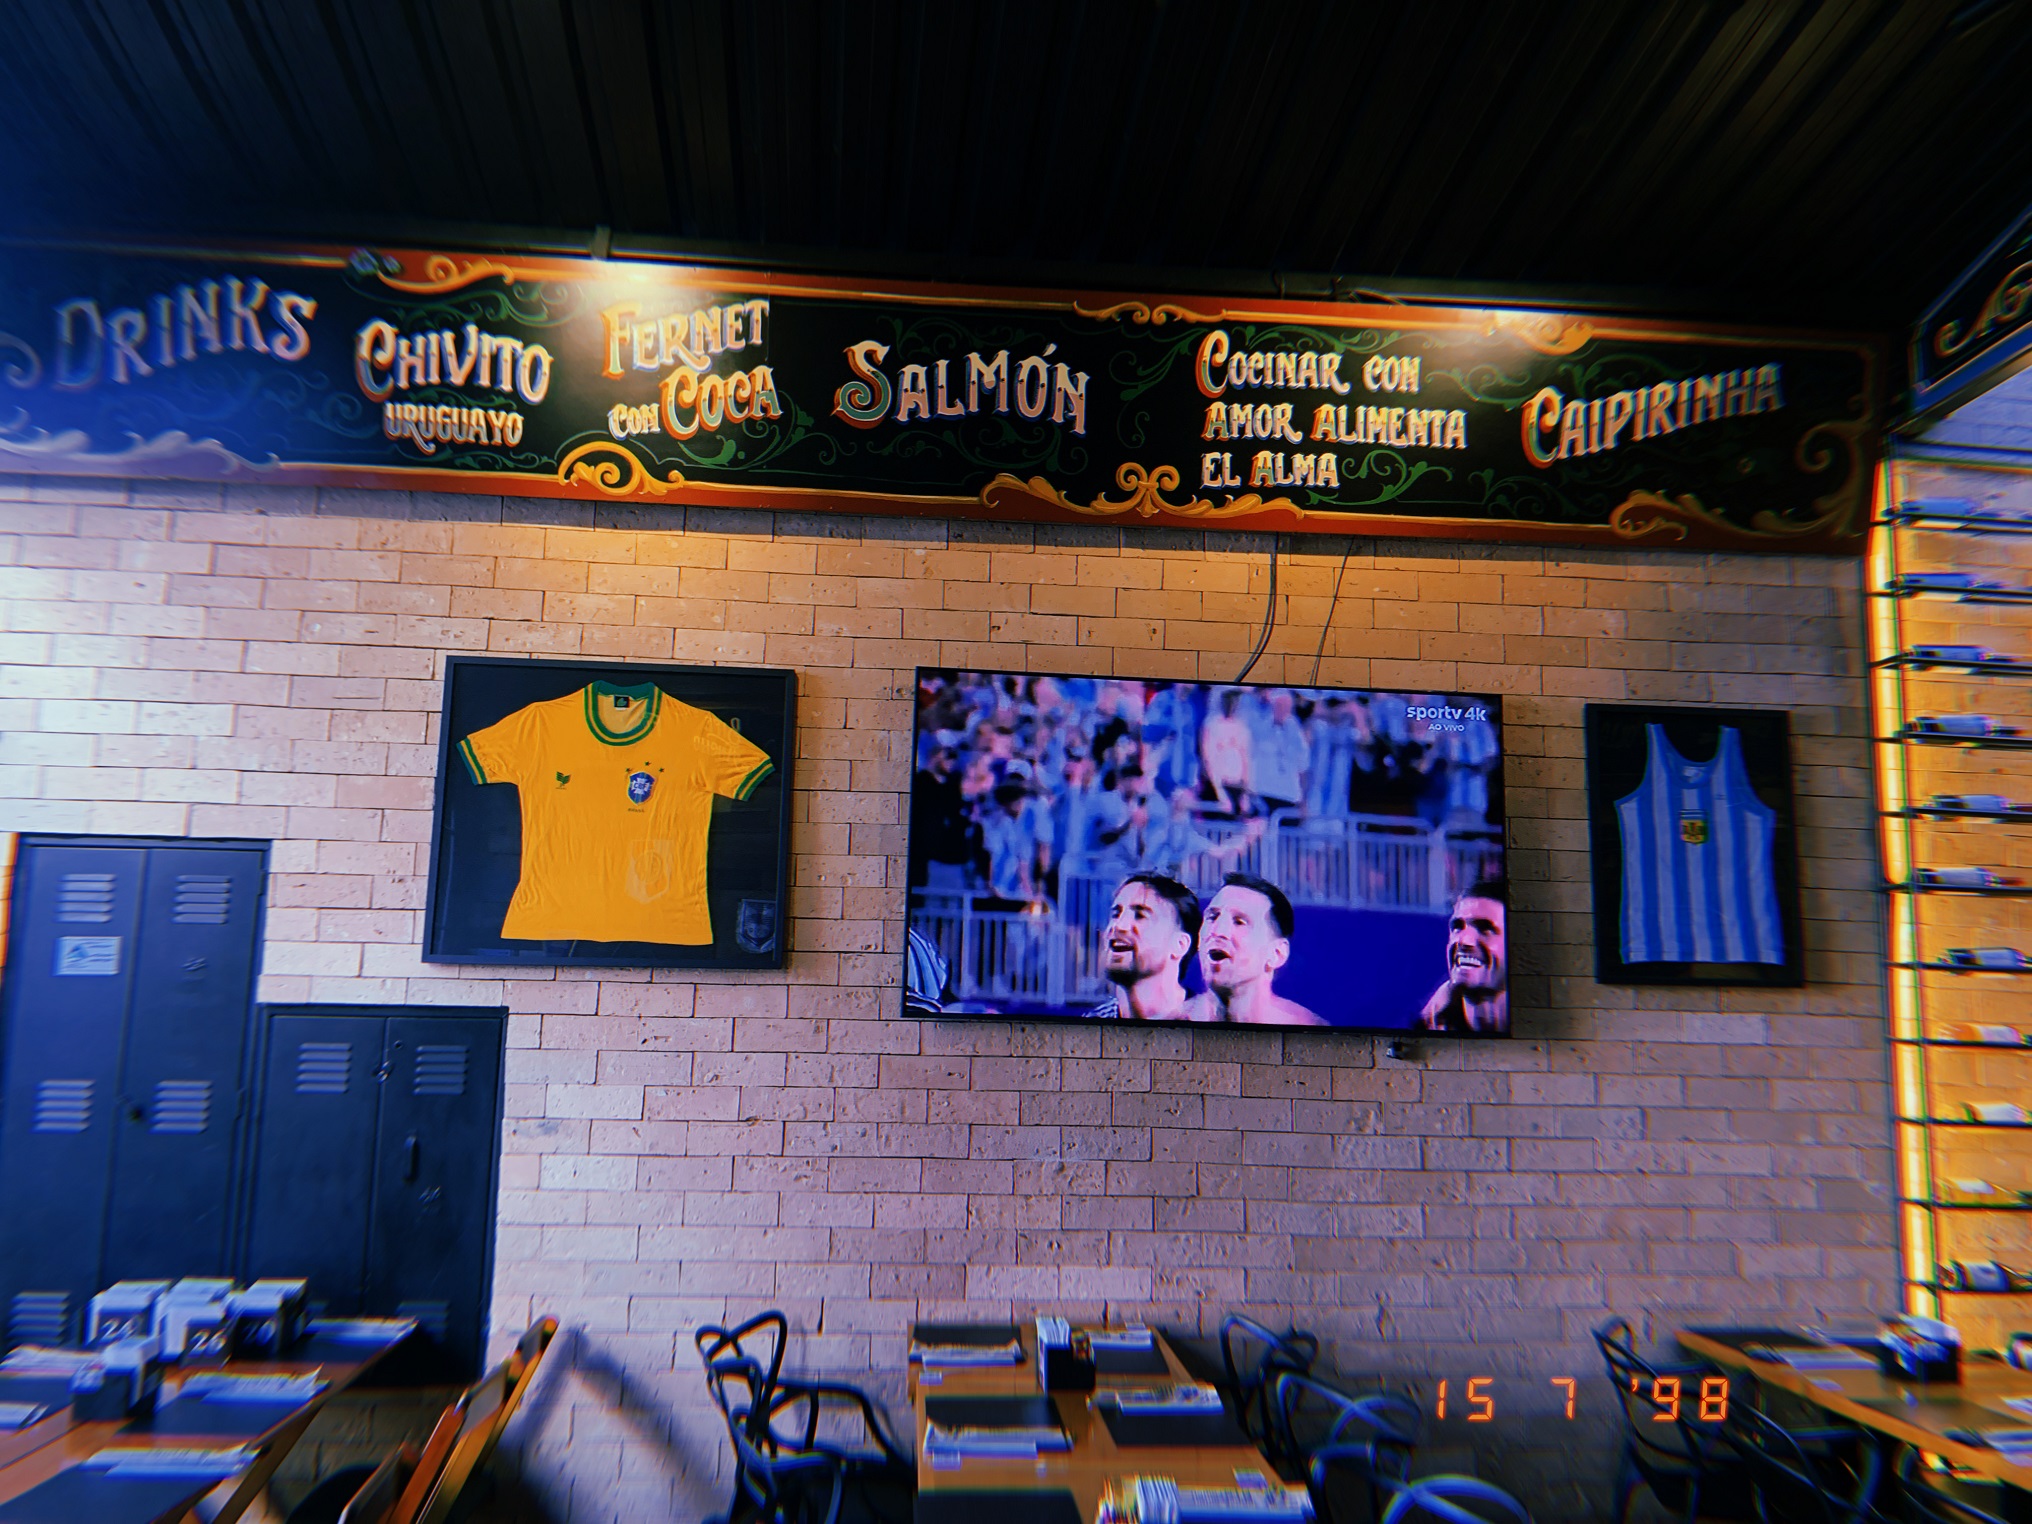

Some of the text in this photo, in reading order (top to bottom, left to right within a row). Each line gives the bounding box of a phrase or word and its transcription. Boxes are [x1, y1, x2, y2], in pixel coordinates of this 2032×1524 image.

[53, 274, 318, 391] DRINKS
[354, 318, 554, 405] CHIVITO
[602, 299, 769, 380] FERNET
[1195, 329, 1423, 398] COCINAR CON
[607, 365, 783, 441] CON COCA
[830, 340, 1091, 436] SALMÓN
[1520, 361, 1784, 468] CAIPIRINHA
[383, 401, 525, 454] URUGUAYO
[1200, 401, 1469, 449] AMOR ALIMENTA
[1199, 449, 1340, 490] EL ALMA
[1406, 705, 1487, 722] sportv 4k
[1428, 723, 1465, 732] AO VIVO
